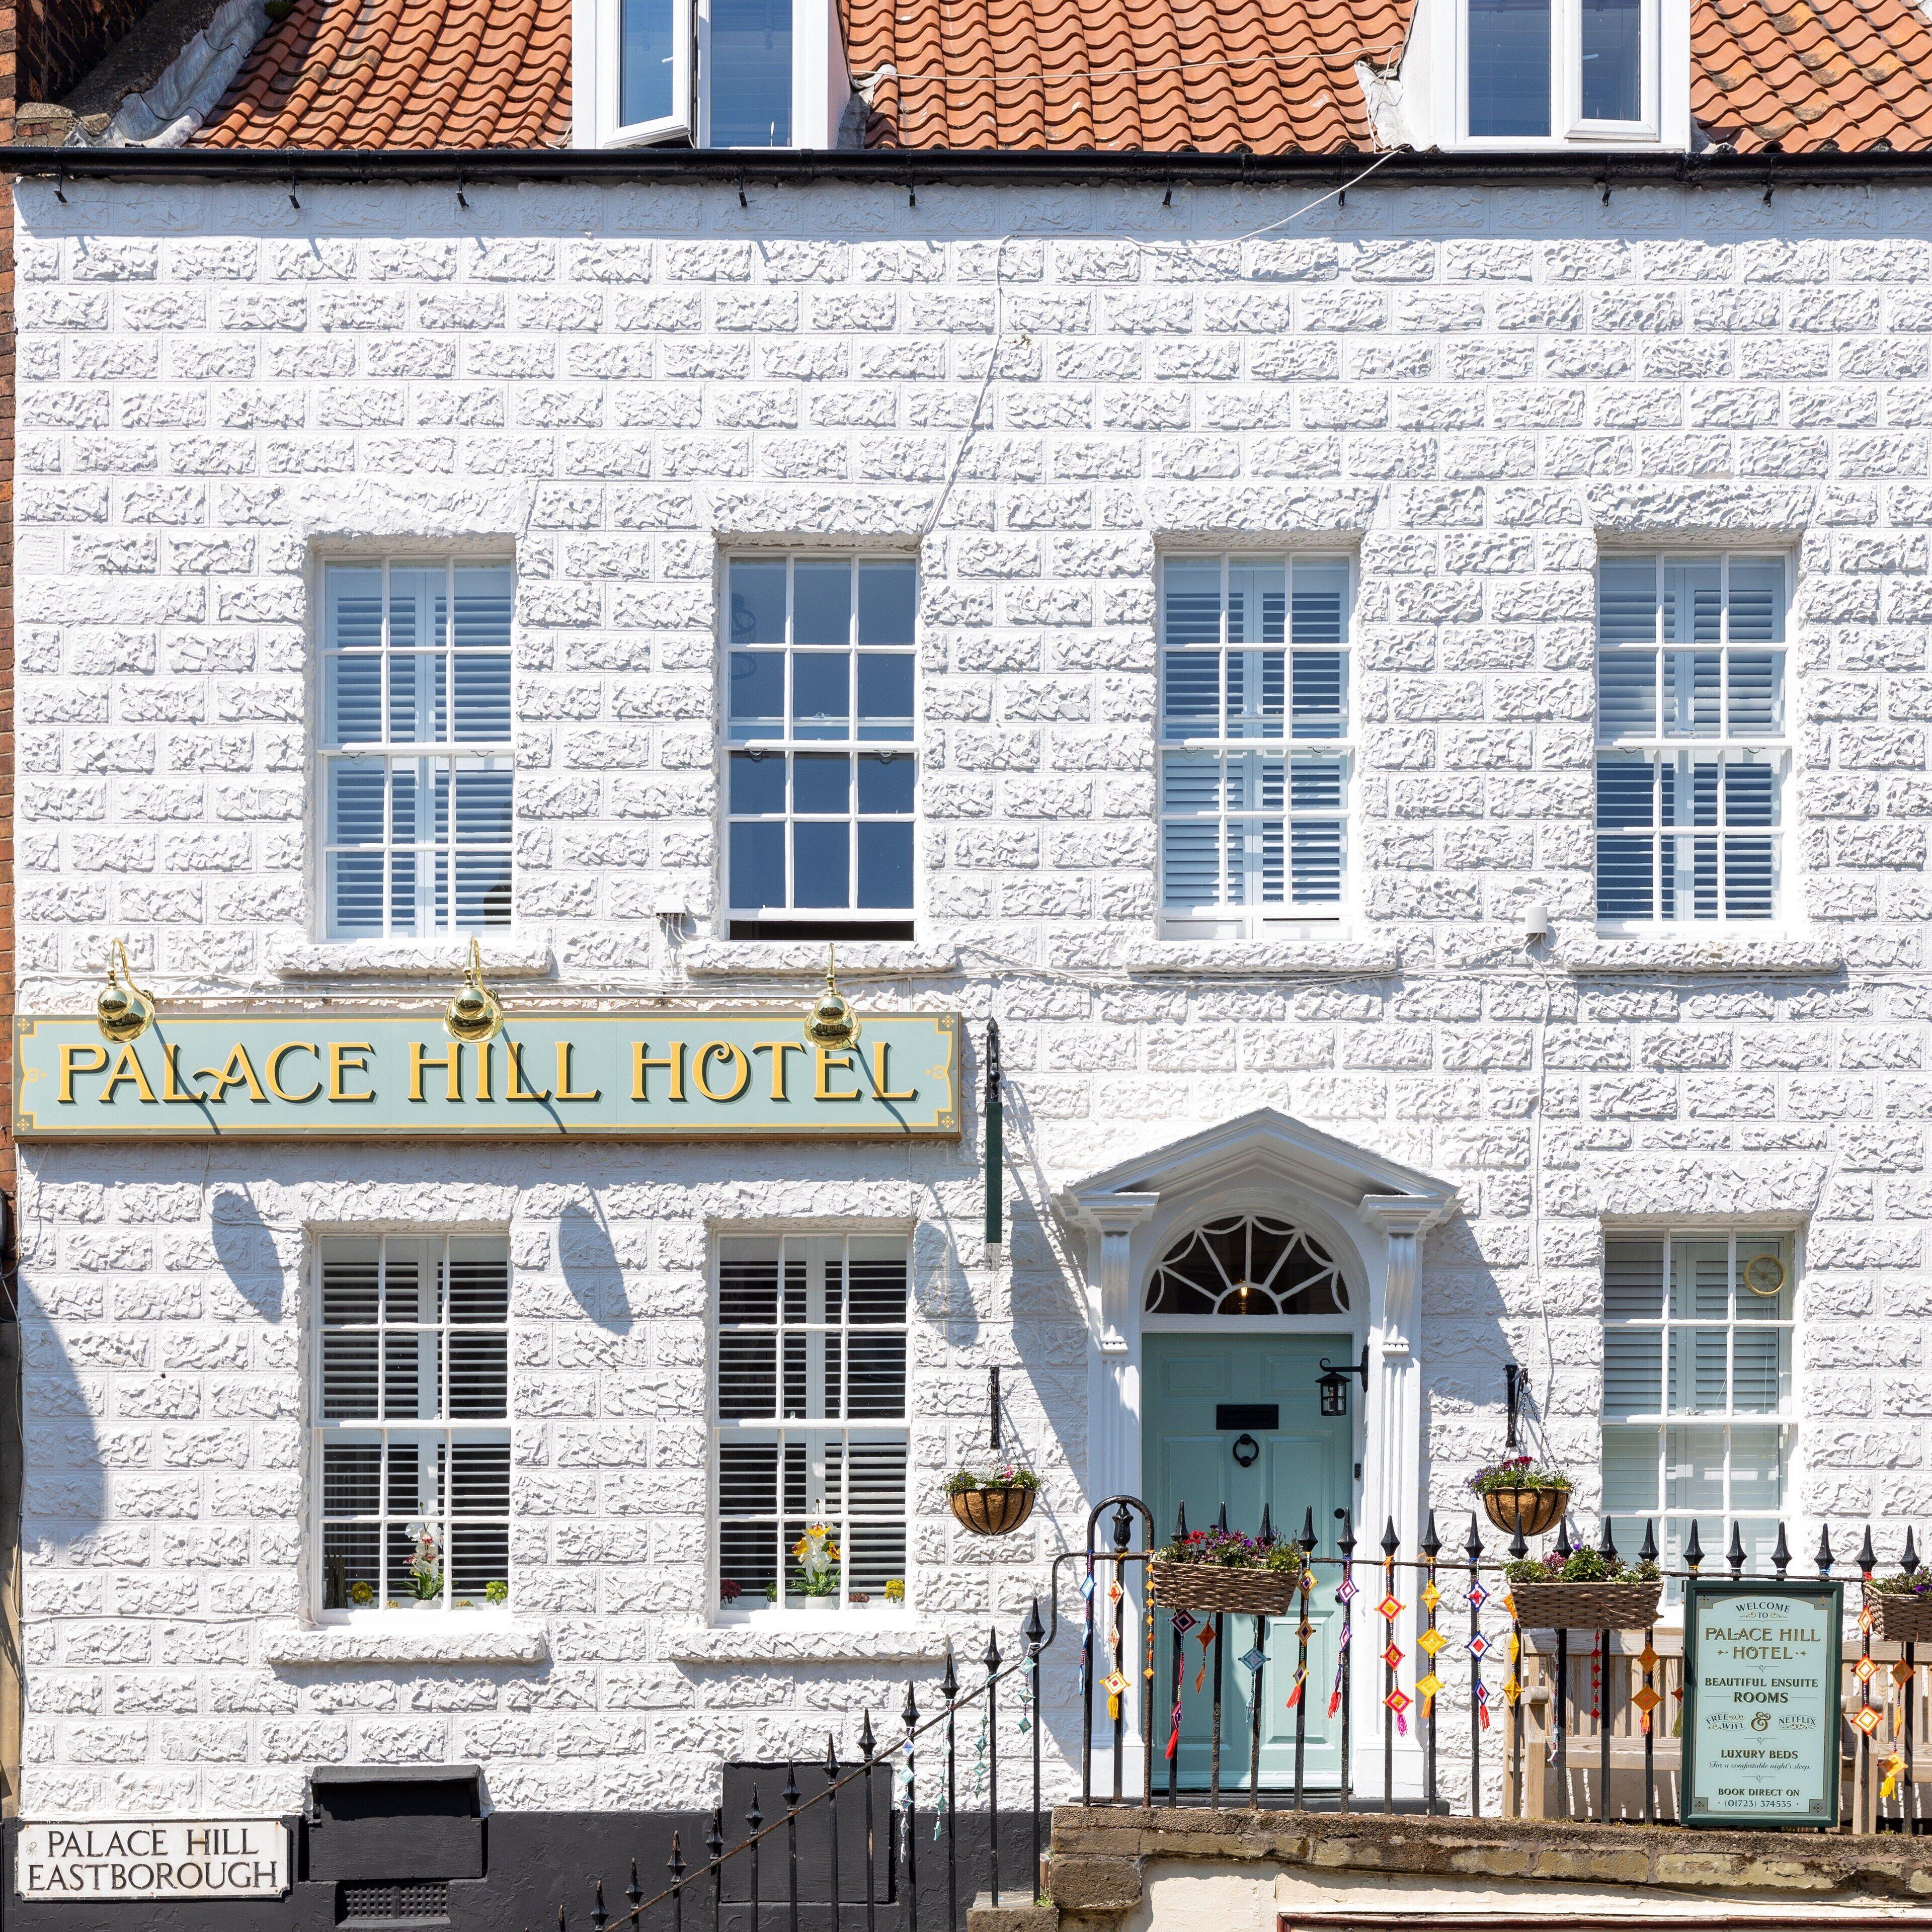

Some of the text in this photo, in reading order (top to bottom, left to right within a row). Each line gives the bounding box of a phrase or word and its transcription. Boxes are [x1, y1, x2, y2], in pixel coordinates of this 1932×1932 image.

[57, 1040, 918, 1104] PALACE HILL HOTEL
[1736, 1601, 1791, 1613] WELCOME
[1706, 1628, 1821, 1642] PALACE HILL
[1733, 1646, 1793, 1660] HOTEL
[1705, 1677, 1818, 1688] BEAUTIFUL ENSUITE
[1734, 1692, 1789, 1704] ROOMS
[1706, 1714, 1728, 1724] FREE
[1751, 1711, 1772, 1731] &
[1779, 1716, 1816, 1726] NETFLIX
[1721, 1749, 1799, 1759] LUXURY BEDS
[1709, 1761, 1722, 1769] For
[1793, 1763, 1811, 1771] sleep.
[1724, 1800, 1792, 1808] (01723) 374535
[48, 1828, 259, 1858] PALACE HILL
[27, 1862, 277, 1891] EASTBOROUGH
